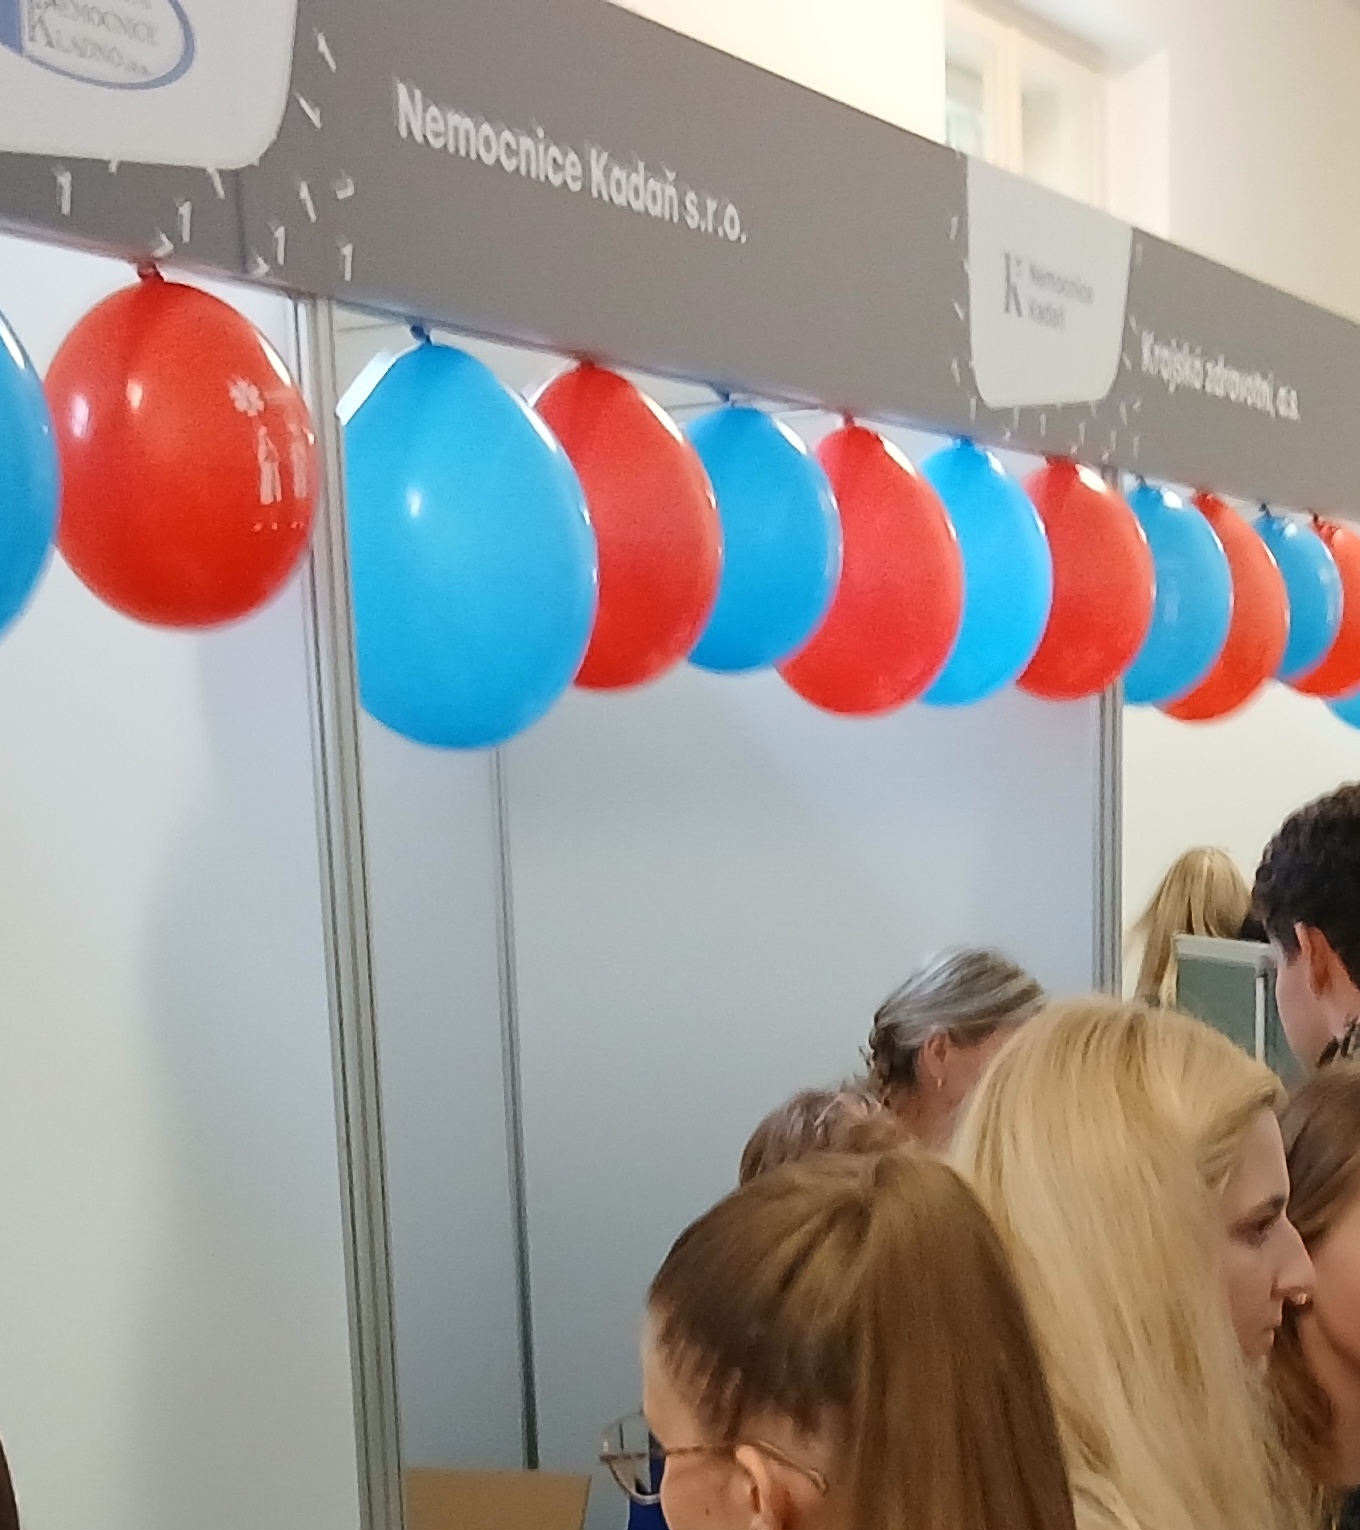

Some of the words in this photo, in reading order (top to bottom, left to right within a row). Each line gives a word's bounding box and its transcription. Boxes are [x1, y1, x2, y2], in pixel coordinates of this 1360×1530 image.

[396, 80, 582, 193] Nemocnice
[589, 146, 679, 224] Kadaň
[684, 190, 748, 245] s.r.o.
